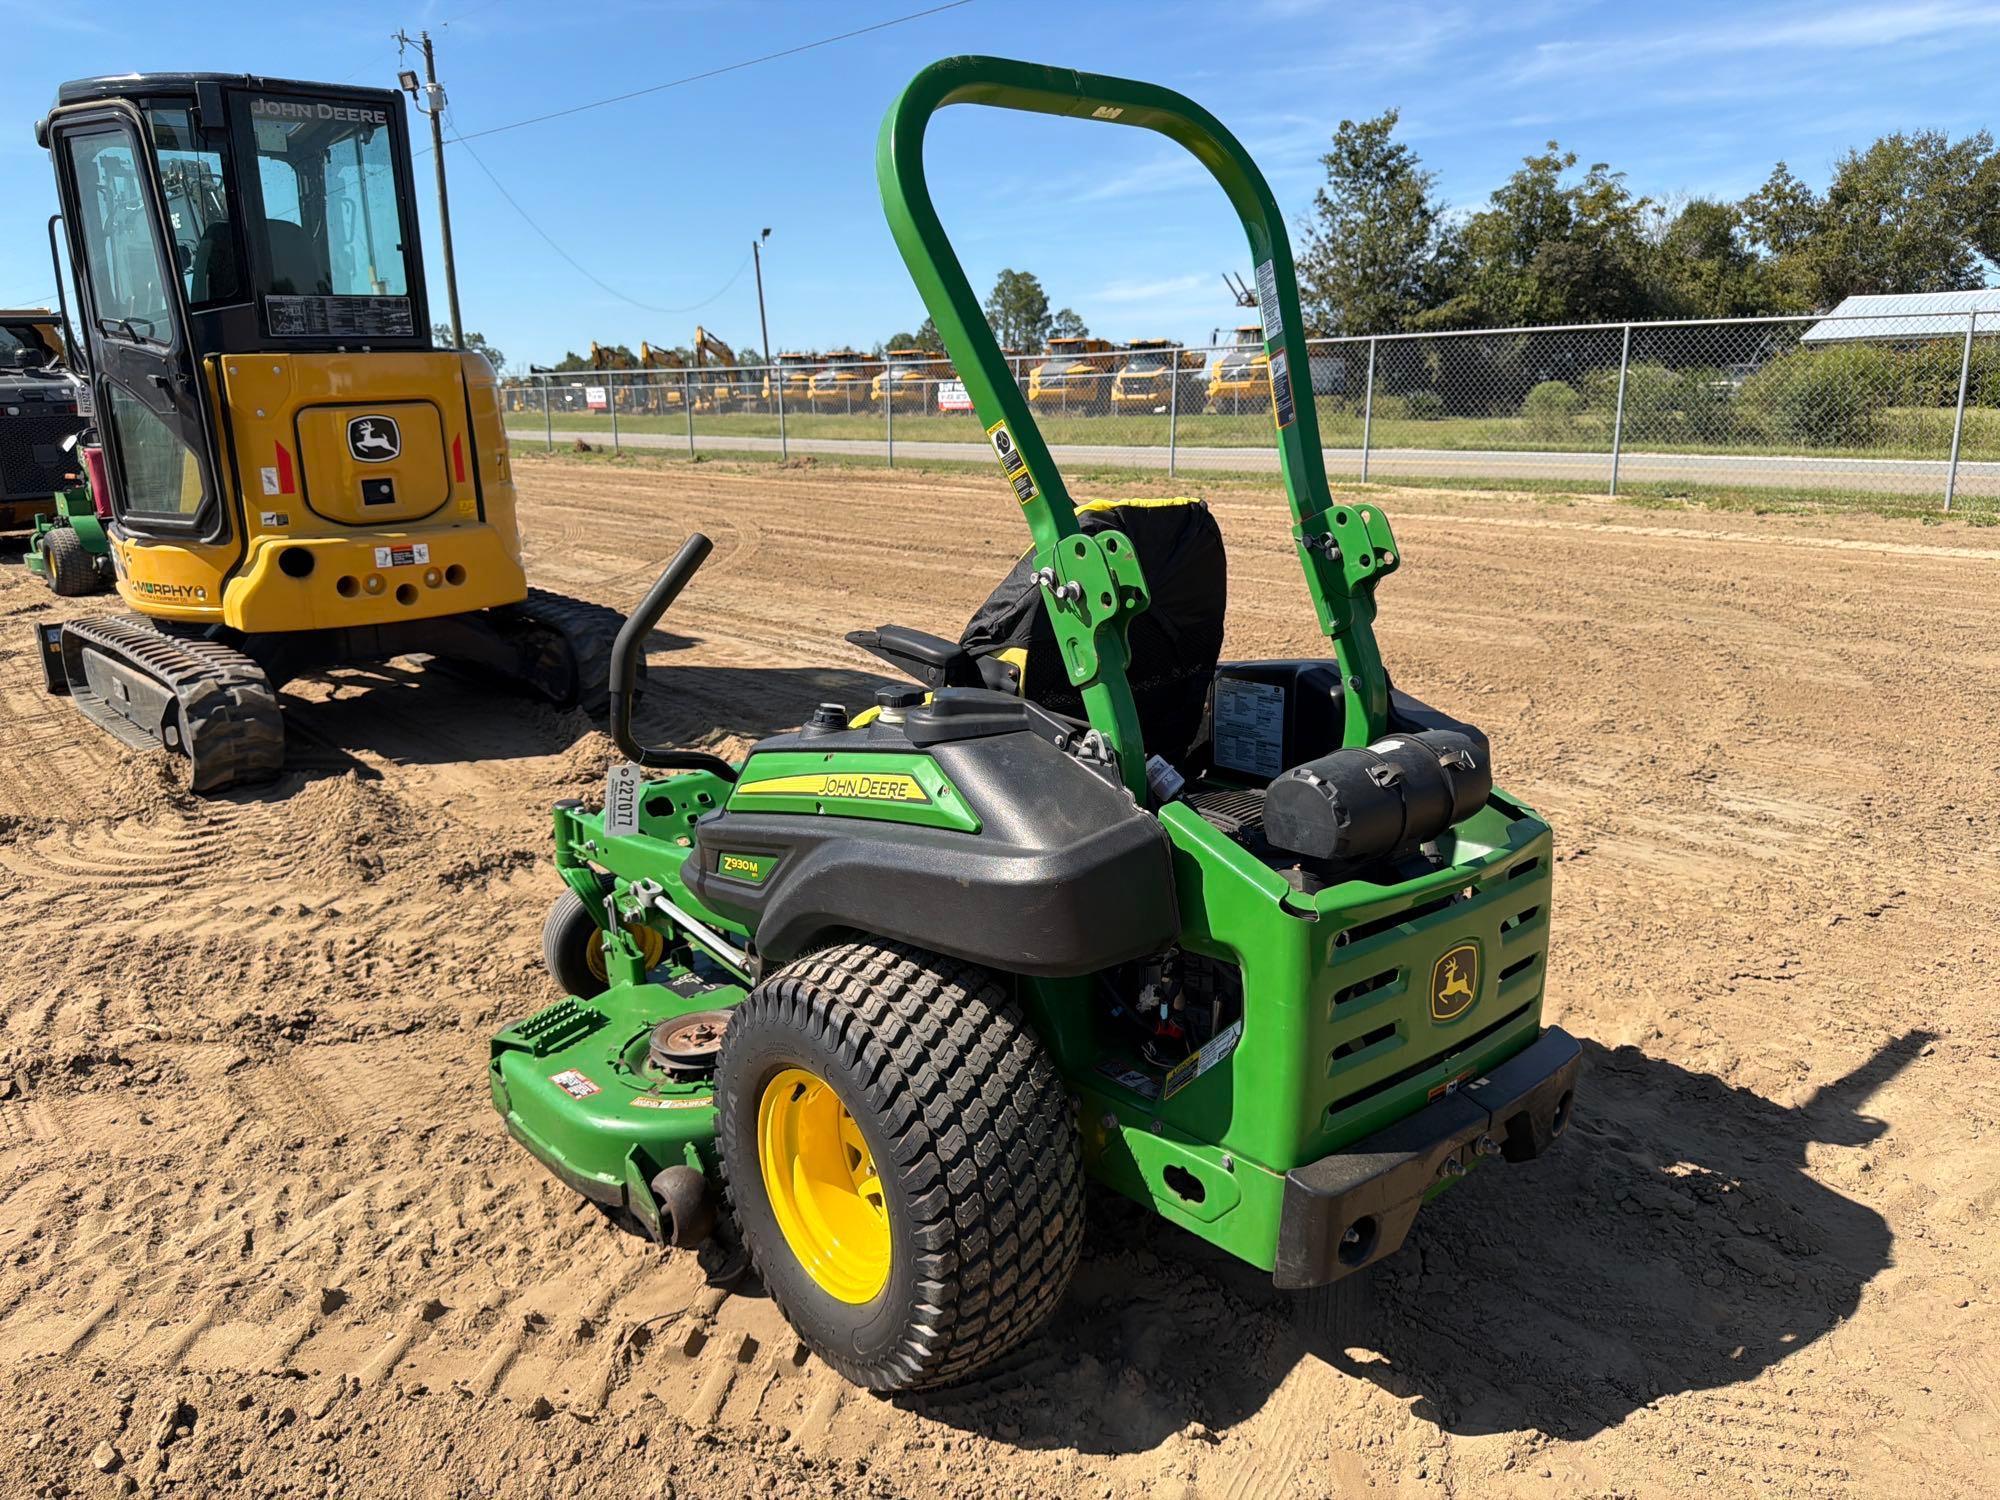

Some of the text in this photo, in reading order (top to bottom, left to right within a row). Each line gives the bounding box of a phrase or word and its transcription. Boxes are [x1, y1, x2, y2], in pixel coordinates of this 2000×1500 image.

[253, 98, 387, 124] JOHN DEERE
[819, 776, 909, 797] JOHN DEERE
[617, 780, 635, 827] 227077
[724, 856, 758, 873] Z930M
